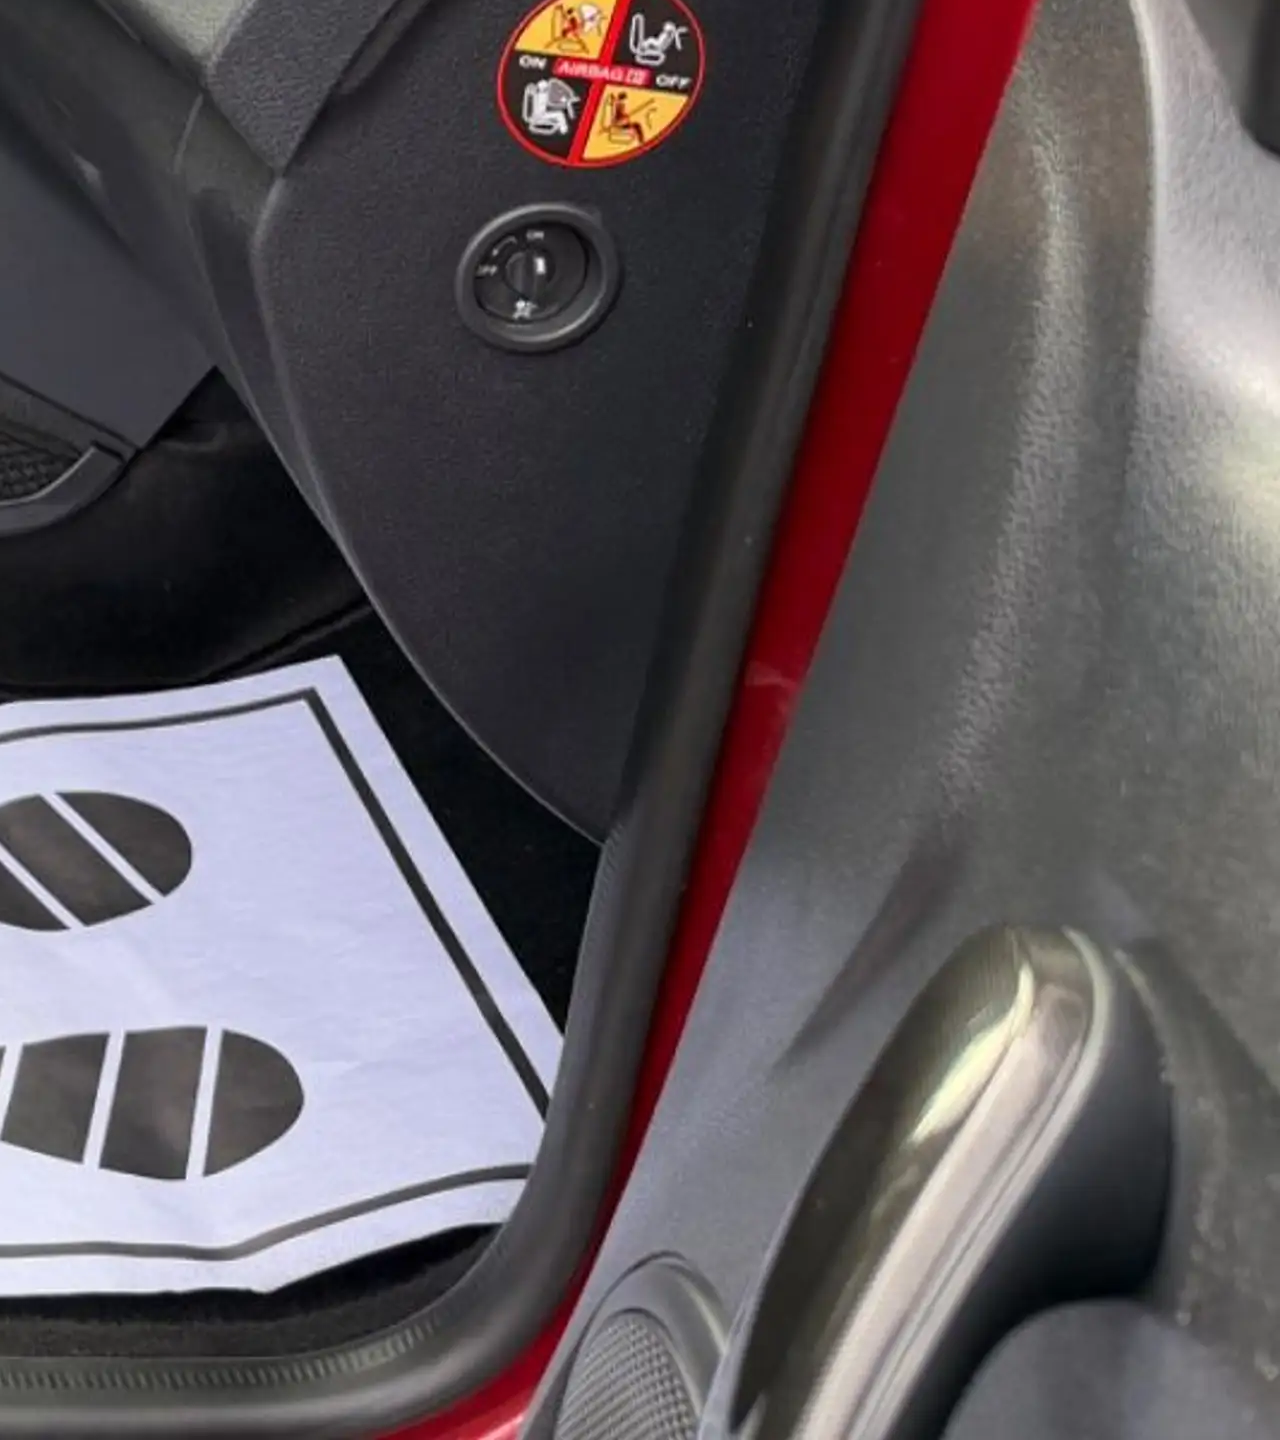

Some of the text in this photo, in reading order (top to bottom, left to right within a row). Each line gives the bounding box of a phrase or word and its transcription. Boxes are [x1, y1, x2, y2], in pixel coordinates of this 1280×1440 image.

[518, 54, 547, 71] ON
[557, 60, 624, 82] AIRBAG
[655, 73, 691, 90] OFF
